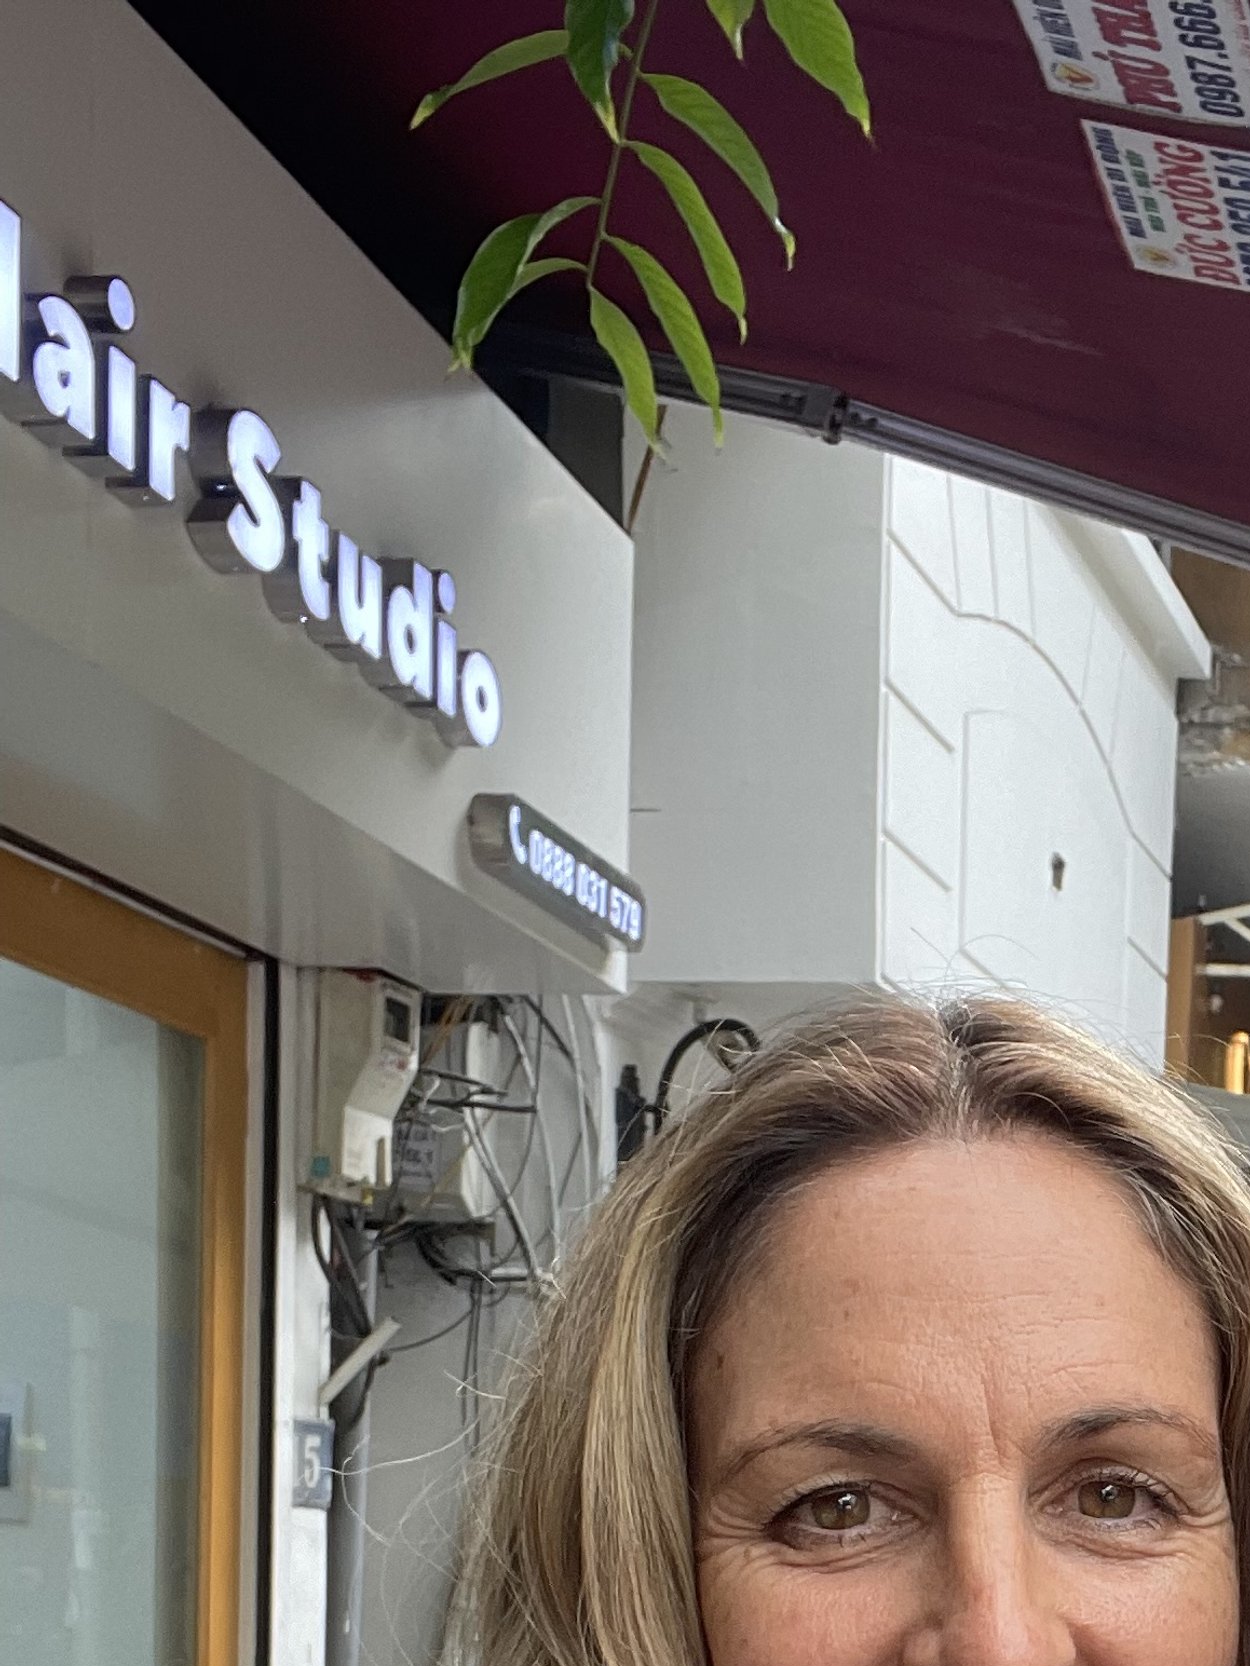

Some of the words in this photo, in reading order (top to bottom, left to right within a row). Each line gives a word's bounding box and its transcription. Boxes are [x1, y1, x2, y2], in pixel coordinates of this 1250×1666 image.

[1092, 50, 1183, 113] PHÚ
[1152, 142, 1225, 231] CƯỜNG
[227, 410, 500, 747] Studio
